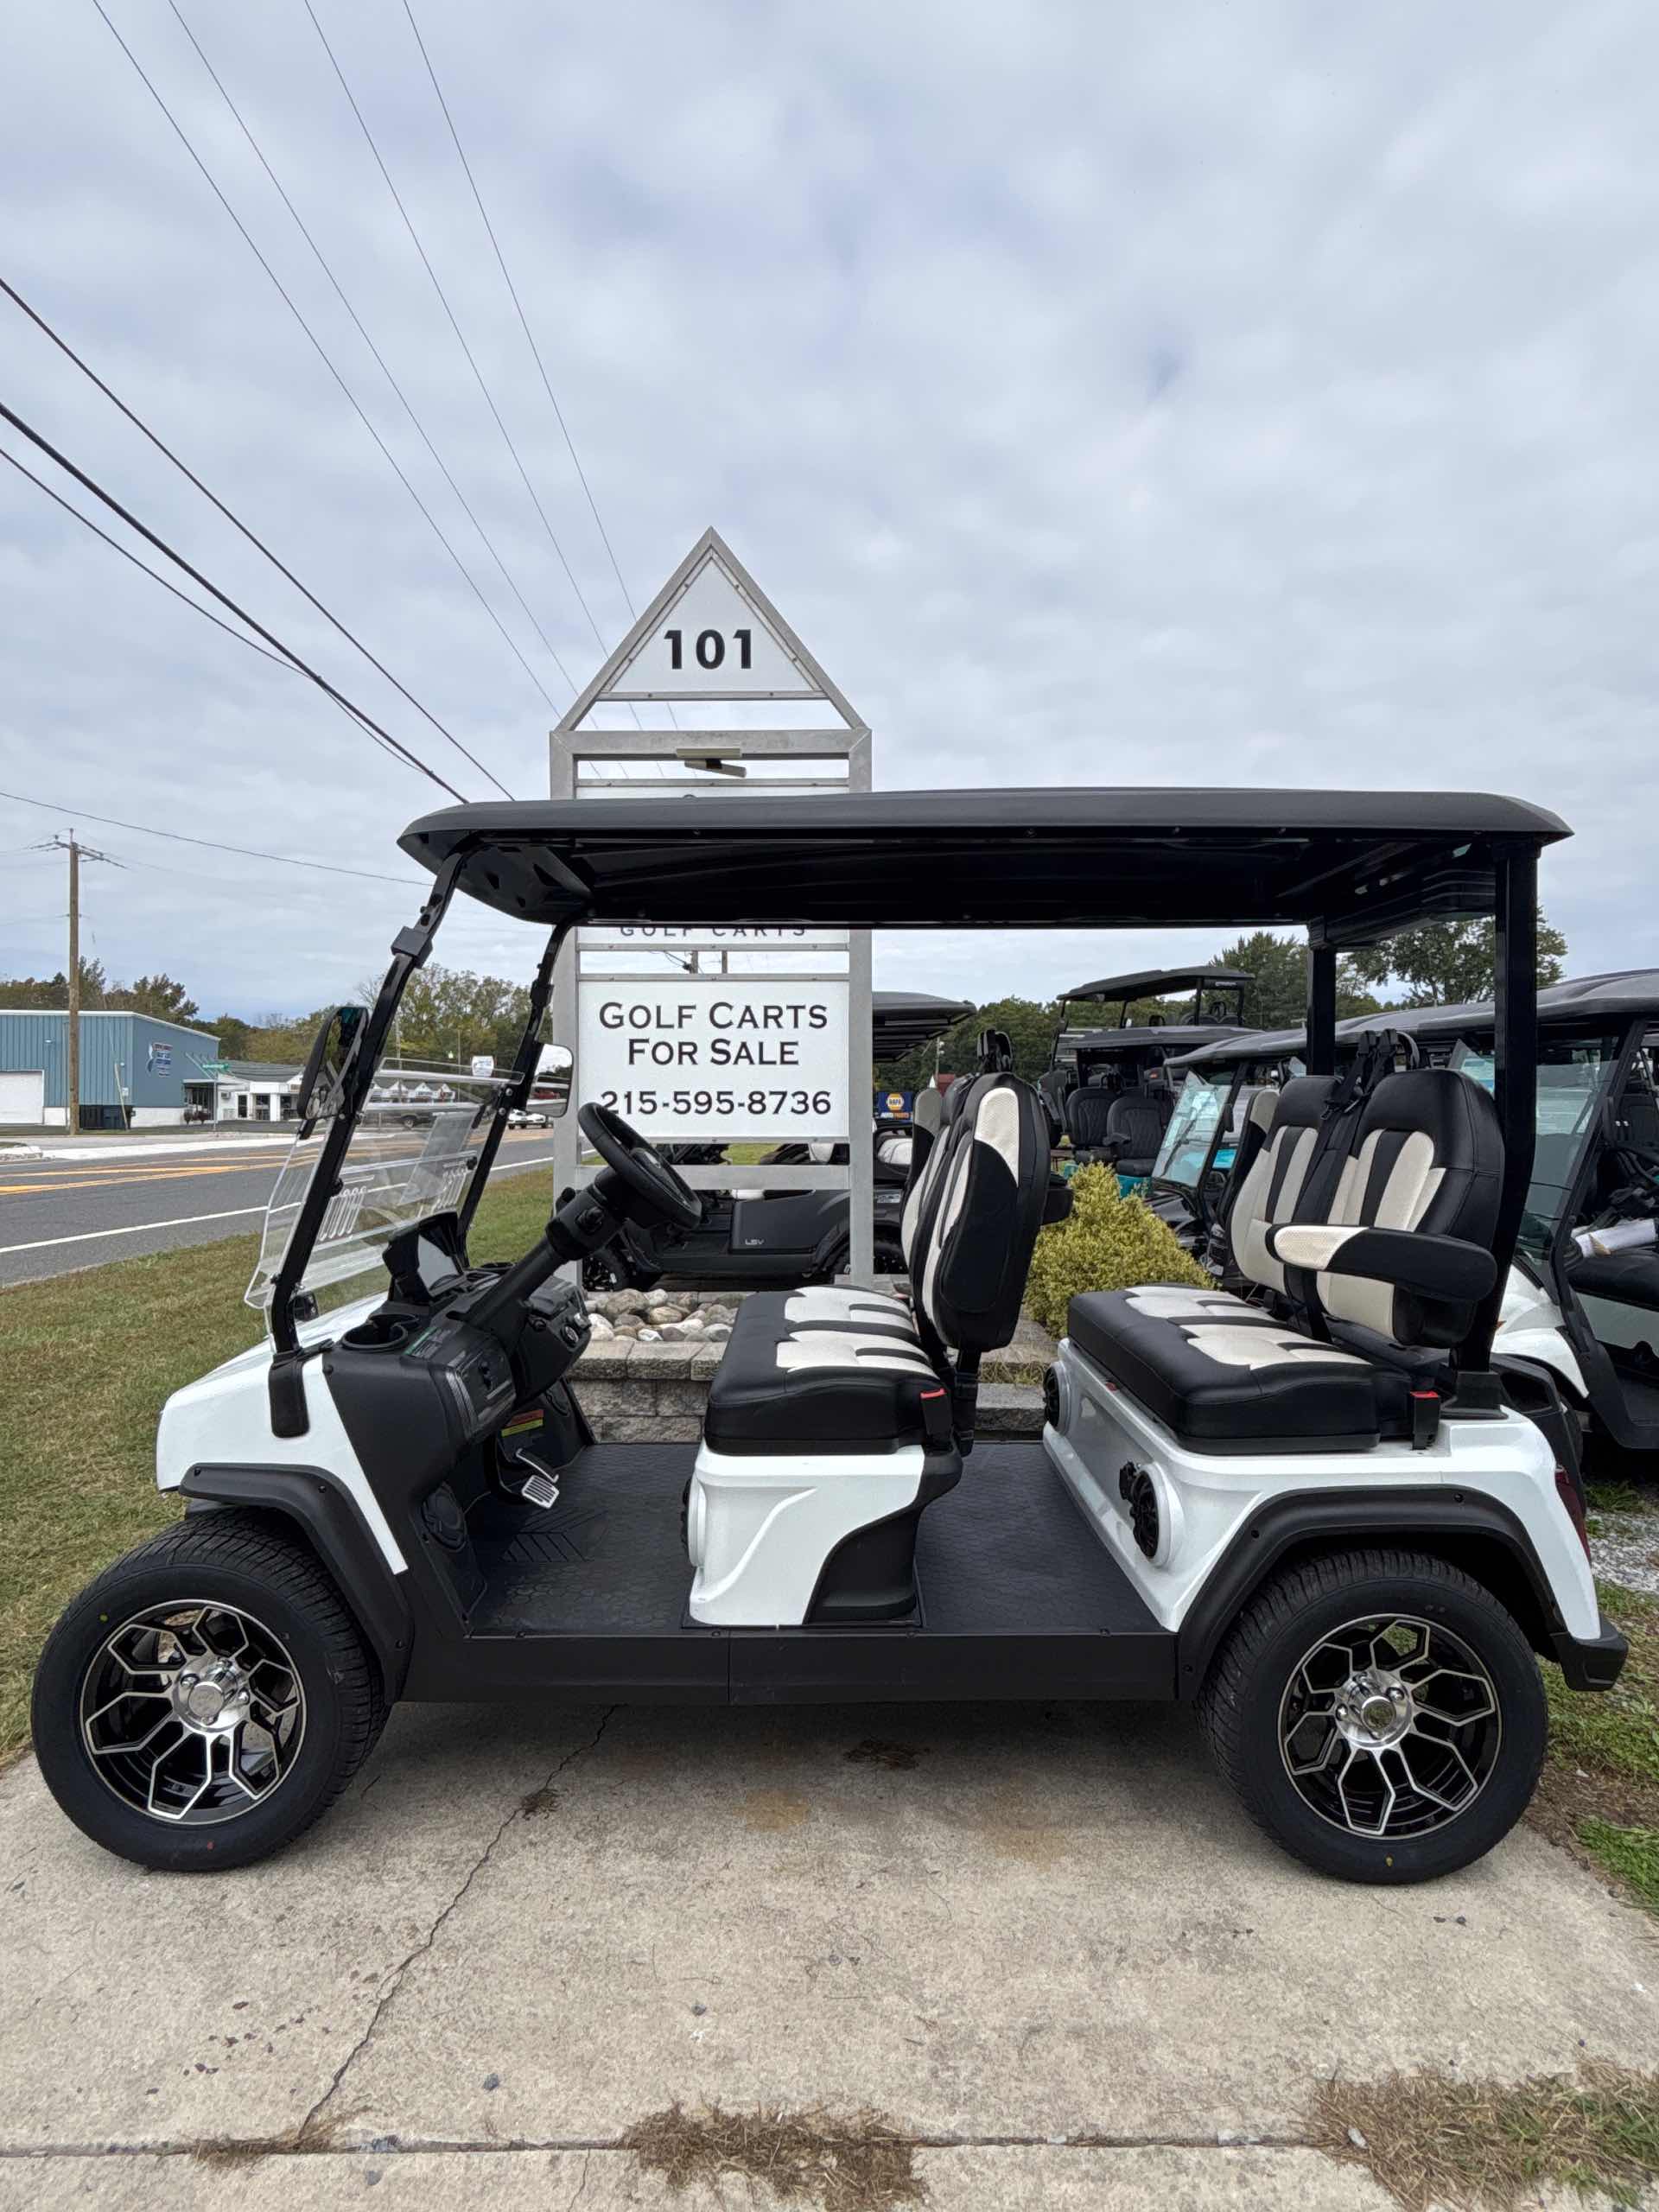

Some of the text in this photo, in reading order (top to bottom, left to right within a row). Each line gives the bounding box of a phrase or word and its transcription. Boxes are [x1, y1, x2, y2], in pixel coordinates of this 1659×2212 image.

[664, 629, 752, 670] 101
[599, 1001, 828, 1029] GOLF CARTS
[628, 1038, 799, 1065] FOR SALE
[601, 1090, 831, 1115] 215-595-8736
